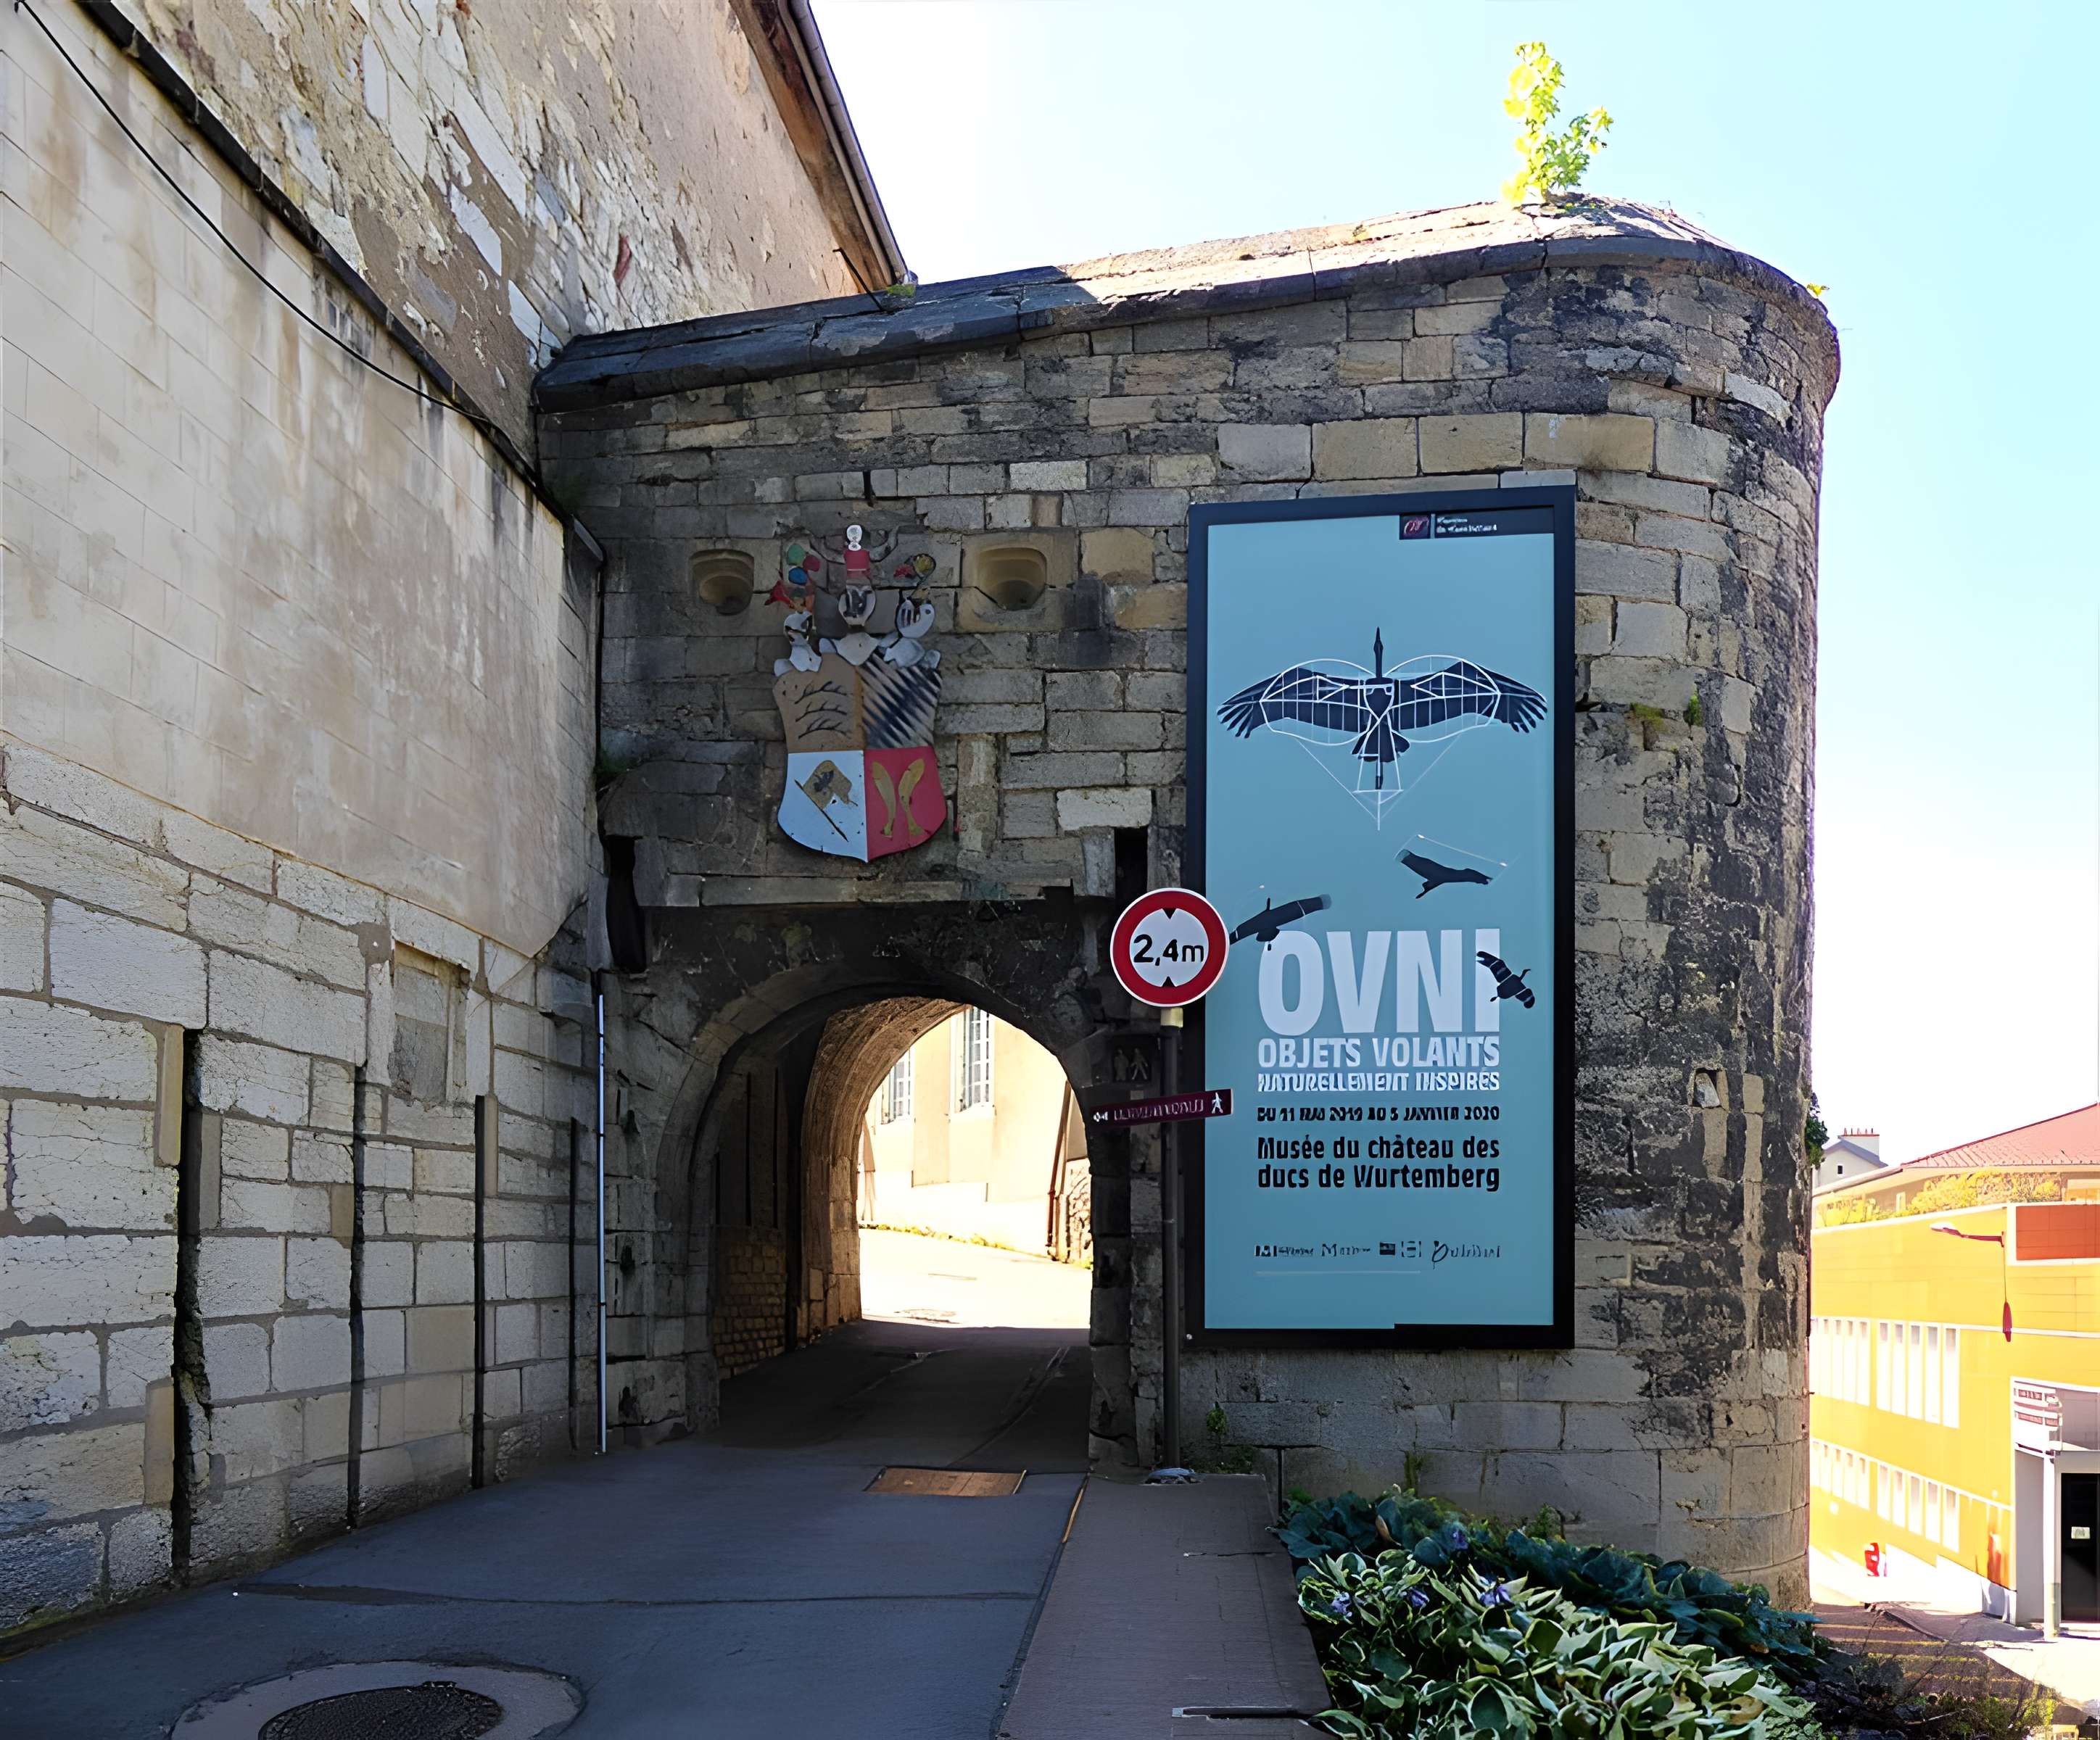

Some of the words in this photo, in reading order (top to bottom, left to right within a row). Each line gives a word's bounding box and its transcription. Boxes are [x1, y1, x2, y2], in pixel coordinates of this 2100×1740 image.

[1133, 935, 1204, 966] 2,4m
[1259, 929, 1500, 1035] OVNI
[1258, 1038, 1361, 1068] OBJETS
[1372, 1036, 1500, 1067] VOLANTS
[1257, 1134, 1324, 1159] Musée
[1334, 1136, 1360, 1159] du
[1368, 1135, 1453, 1159] château
[1463, 1135, 1500, 1159] des
[1258, 1164, 1309, 1188] ducs
[1318, 1164, 1344, 1188] de
[1355, 1164, 1500, 1192] Wurtemberg
